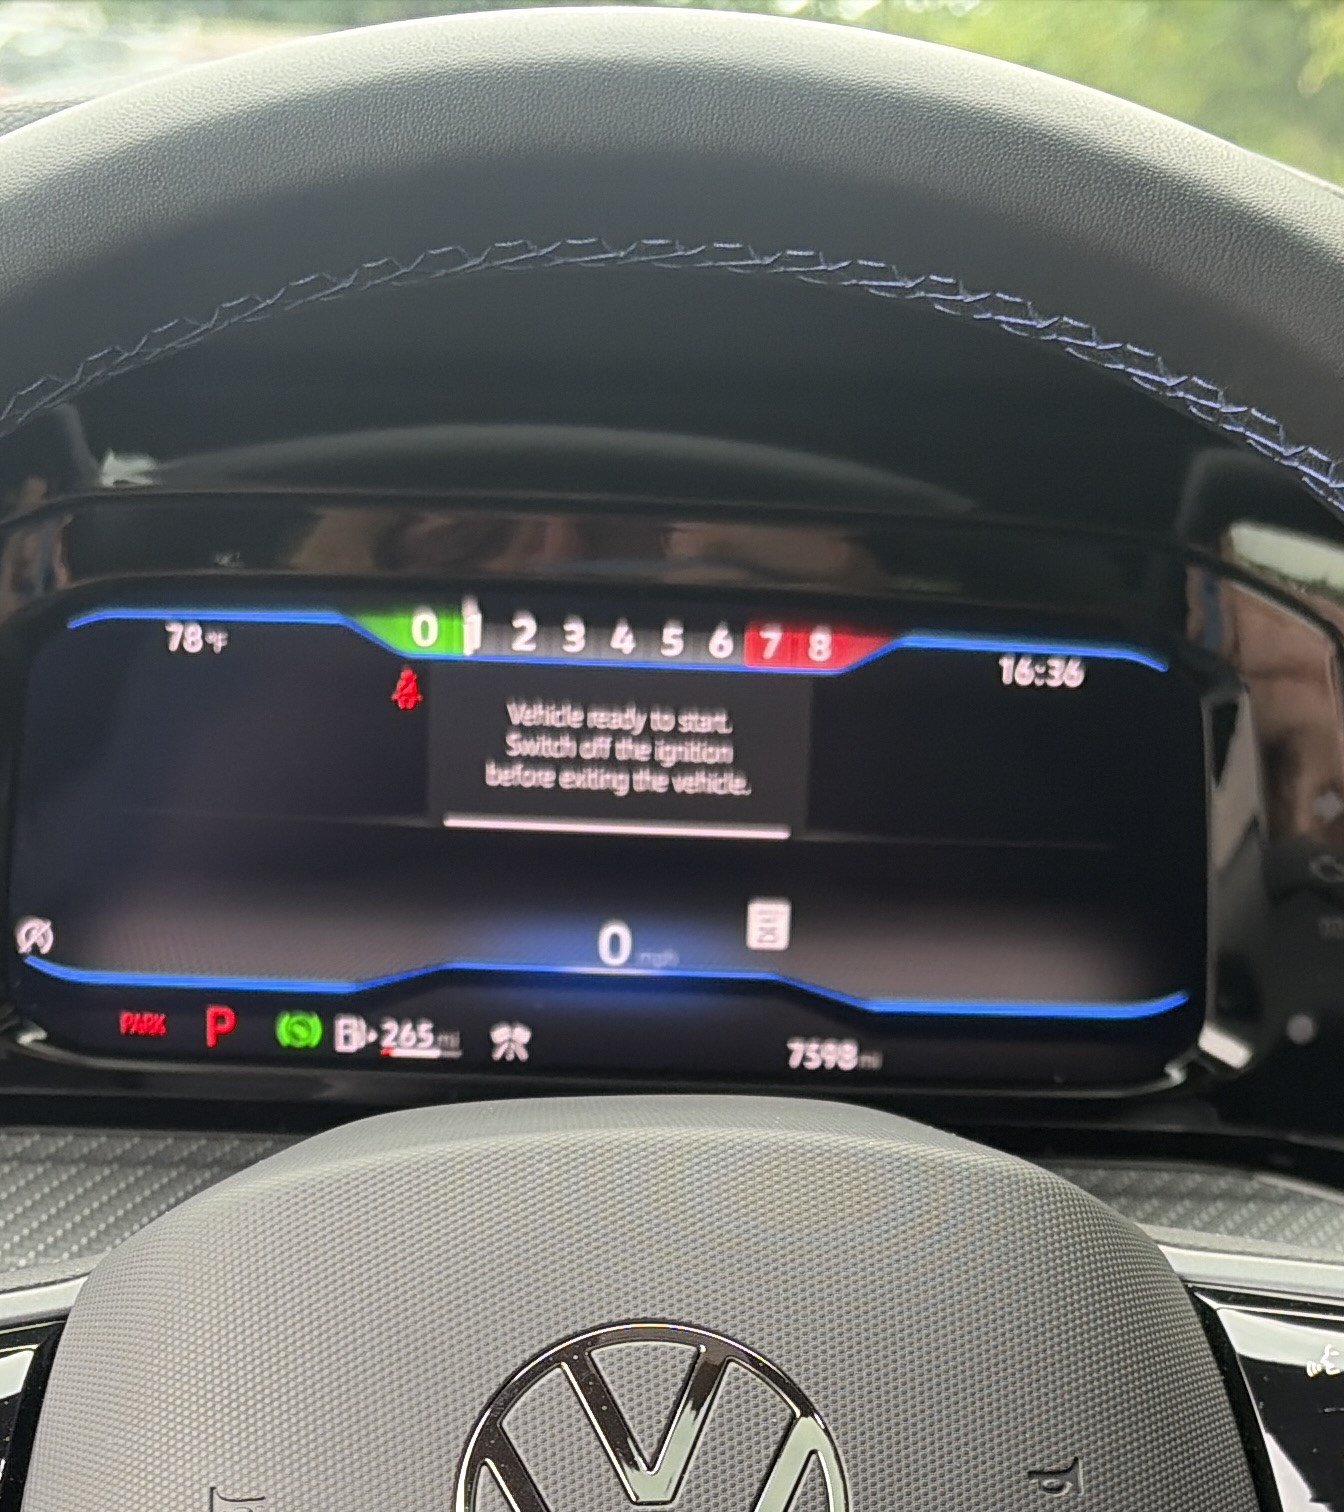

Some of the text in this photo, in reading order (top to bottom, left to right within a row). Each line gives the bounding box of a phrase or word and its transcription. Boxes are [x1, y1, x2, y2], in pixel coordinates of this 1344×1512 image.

[411, 606, 438, 648] 0
[511, 612, 537, 651] 2
[562, 615, 586, 653] 3
[610, 617, 636, 655] 4
[660, 620, 684, 657] 5
[708, 622, 734, 659] 6
[759, 624, 783, 660] 7
[808, 627, 832, 662] 8
[998, 653, 1085, 688] 16:36
[506, 697, 585, 729] Vehicle
[586, 701, 648, 736] ready
[650, 703, 677, 733] to
[506, 729, 734, 768] Switch off the ignition
[485, 757, 556, 788] before
[558, 763, 631, 797] exiting
[632, 767, 670, 793] the
[598, 921, 632, 967] 0
[119, 1011, 168, 1038] PARK
[206, 1005, 237, 1048] P
[380, 1016, 435, 1048] 265
[786, 1037, 859, 1072] 7598
